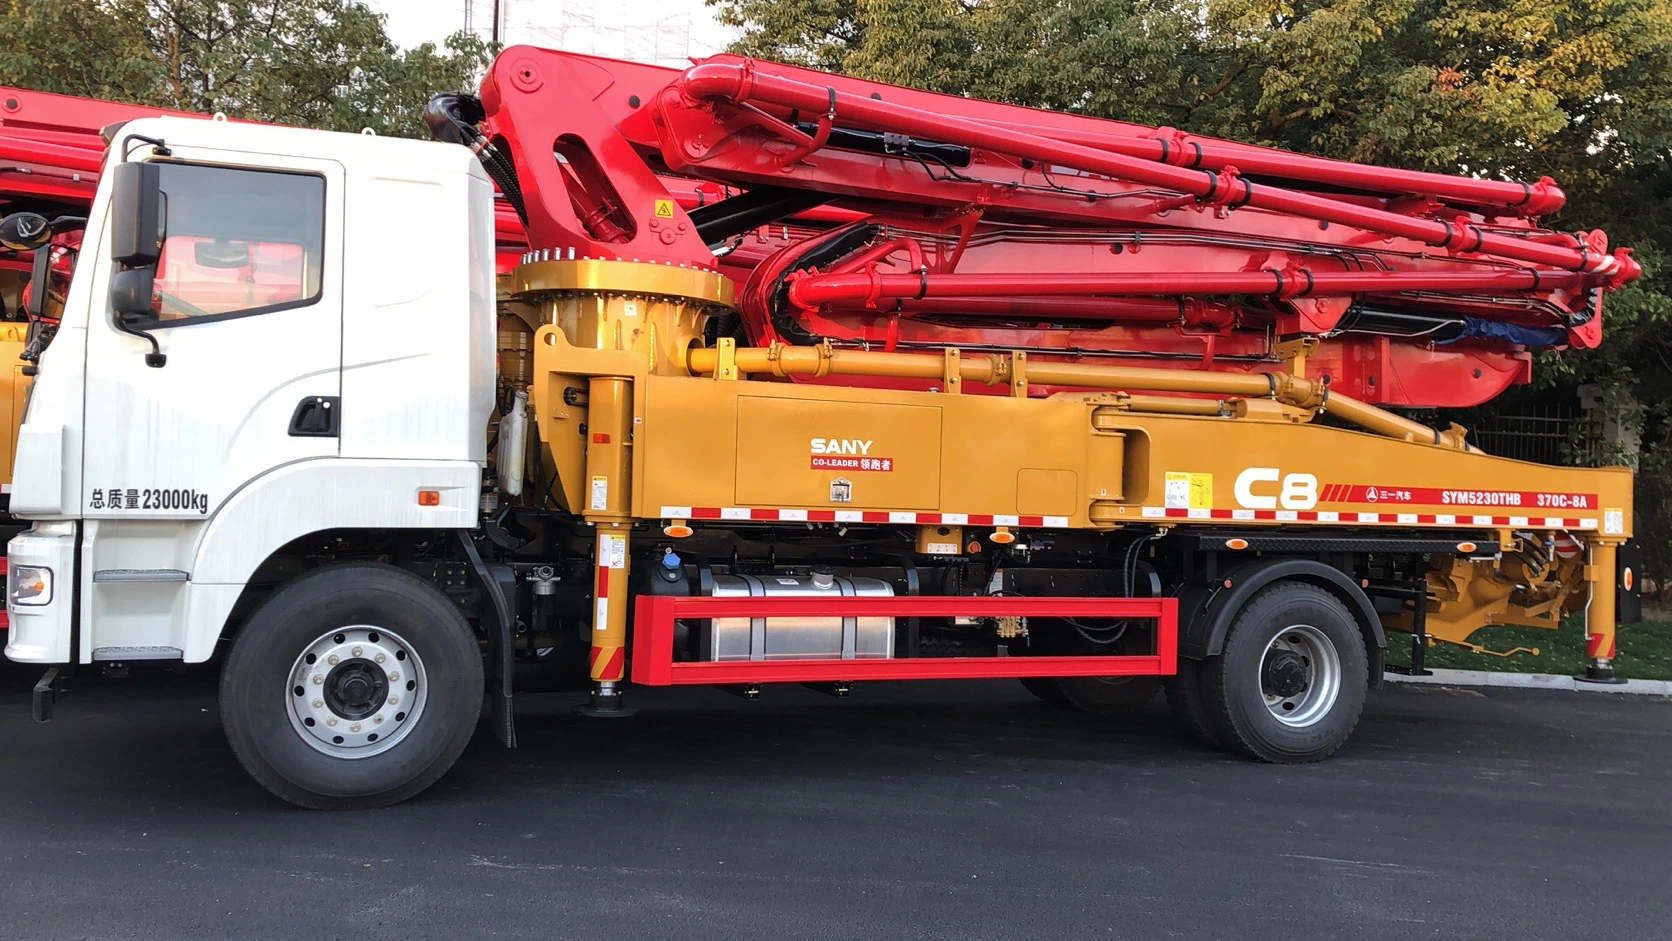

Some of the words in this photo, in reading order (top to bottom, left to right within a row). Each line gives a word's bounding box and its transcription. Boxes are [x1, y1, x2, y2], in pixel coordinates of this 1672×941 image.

[811, 438, 873, 455] SANY
[812, 458, 859, 468] CO-LEADER
[860, 458, 891, 471] 领跑者
[1234, 467, 1318, 510] C8
[1380, 490, 1412, 501] 三一汽车
[90, 488, 208, 514] 总质量23000kg
[1442, 491, 1521, 506] SYM5230THB
[1537, 494, 1588, 509] 370C-8A
